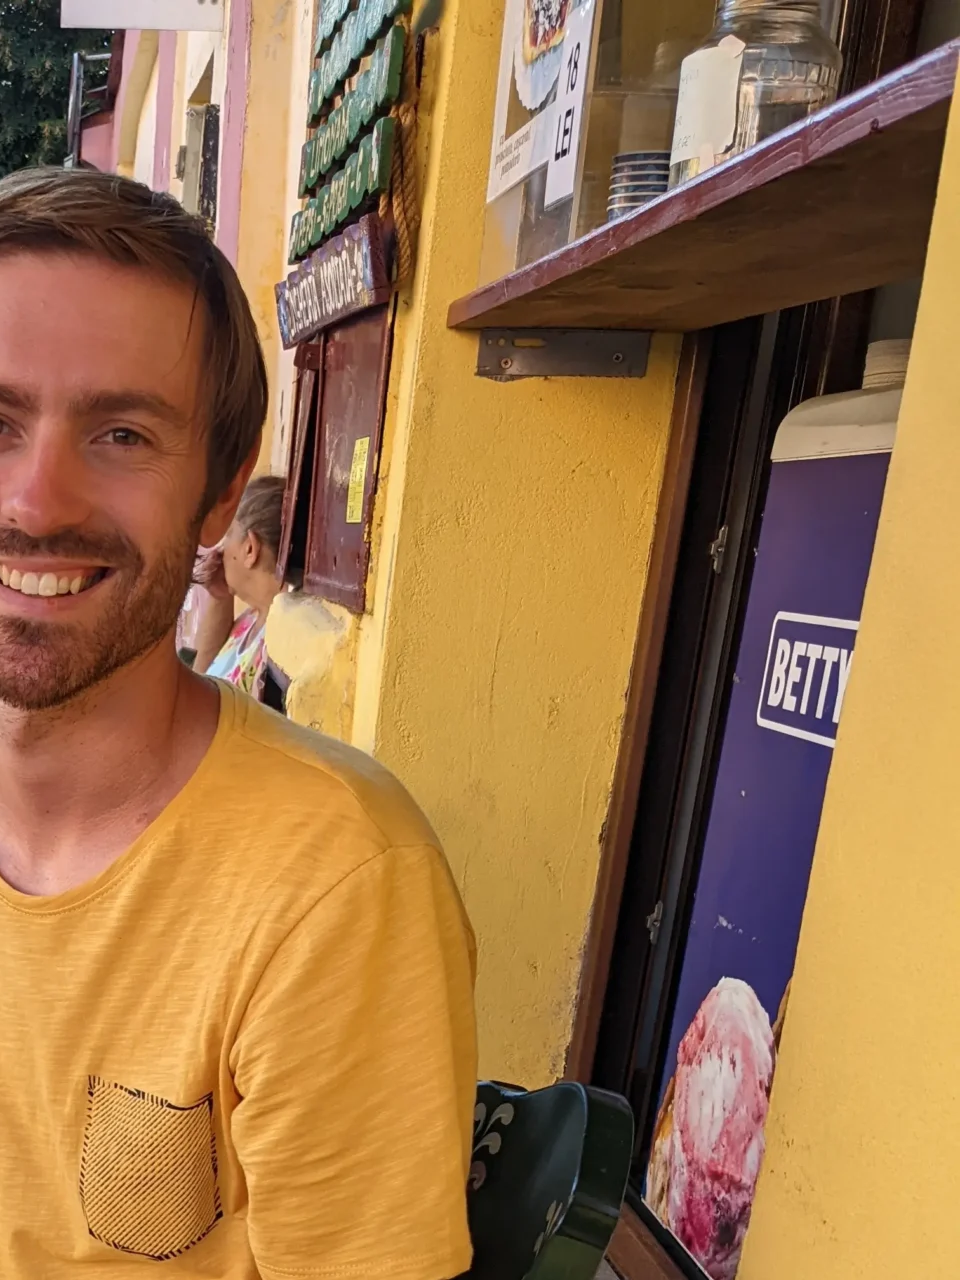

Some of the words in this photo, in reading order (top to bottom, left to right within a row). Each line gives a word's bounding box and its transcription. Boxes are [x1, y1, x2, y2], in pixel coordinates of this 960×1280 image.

[566, 42, 580, 95] 18
[555, 106, 575, 162] LEI
[767, 638, 854, 723] BETTY
